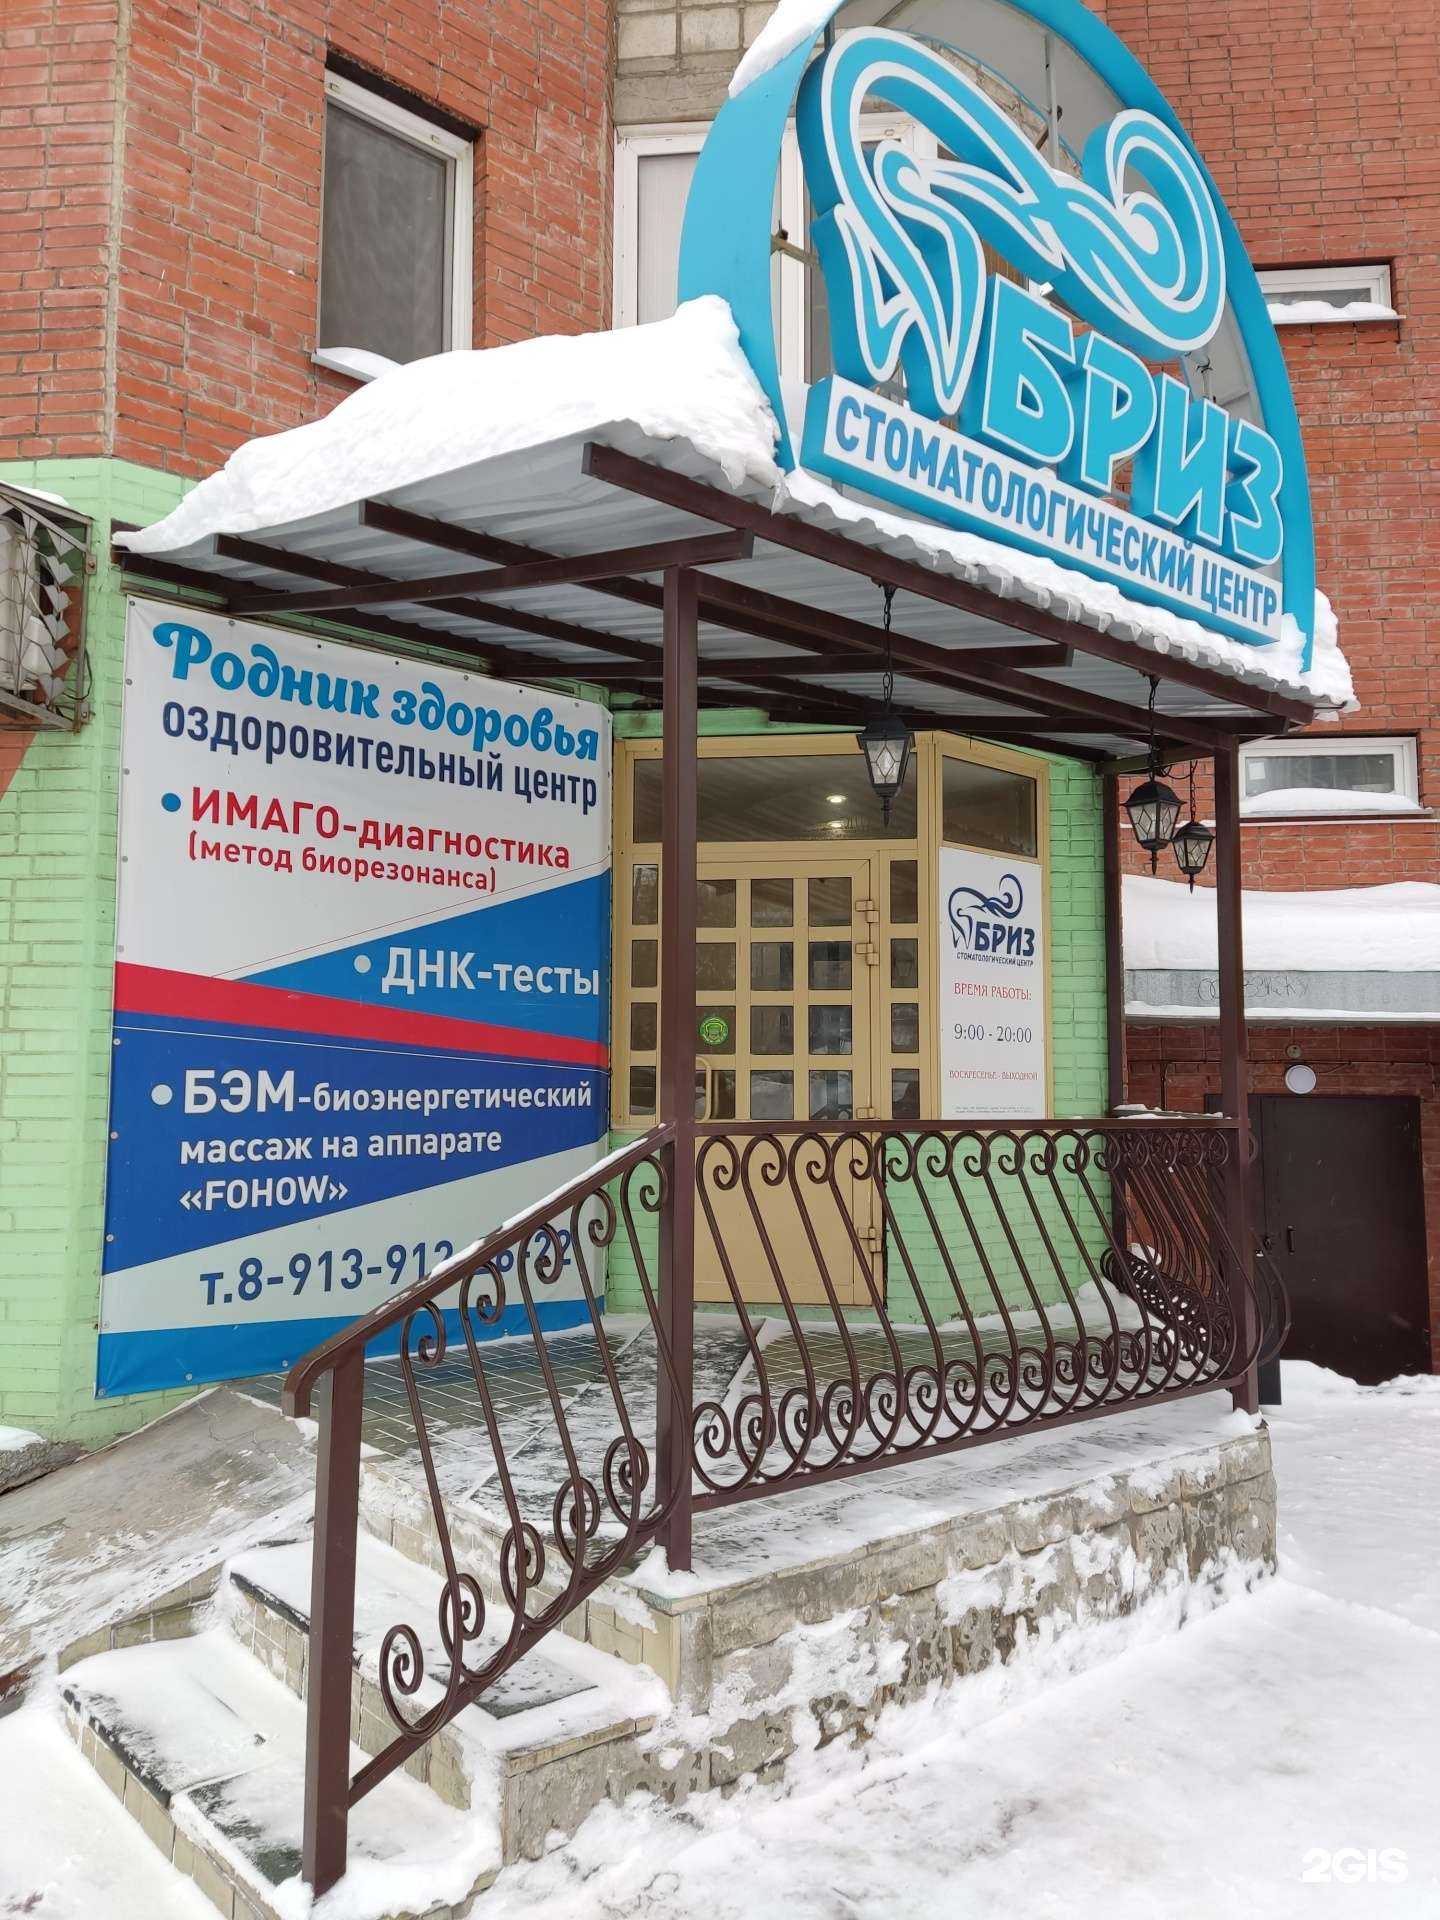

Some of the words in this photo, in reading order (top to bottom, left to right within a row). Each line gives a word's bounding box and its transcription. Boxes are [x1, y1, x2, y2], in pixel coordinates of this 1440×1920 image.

[981, 273, 1284, 566] БРИЗ
[836, 395, 1193, 596] СТОМАТОЛОГИЧЕСКИЙ
[1200, 559, 1277, 626] ЦЕНТР
[153, 621, 379, 719] Родник
[391, 681, 599, 761] здоровья
[163, 701, 503, 792] оздоровительный
[515, 764, 598, 816] центр
[192, 786, 570, 869] ИМАГО-диагностика
[188, 830, 292, 873] (метод
[302, 847, 496, 893] биорезонанса)
[956, 951, 1016, 966] СТОМАТОЛОГИЧЕСКИЙ
[1017, 958, 1034, 967] ЦЕНТР
[974, 921, 1035, 956] БРИЗ
[381, 946, 600, 996] ДНК-тесты
[954, 982, 988, 996] ВРЕМЯ
[991, 985, 1032, 1001] РАБОТЫ:
[954, 1023, 984, 1041] 9:00
[997, 1026, 1032, 1043] 20:00
[184, 1069, 592, 1118] БЭМ-биоэнергетический
[180, 1130, 312, 1164] массаж
[322, 1134, 357, 1159] на
[368, 1128, 502, 1161] аппарате
[179, 1175, 348, 1212] «FOHOW»
